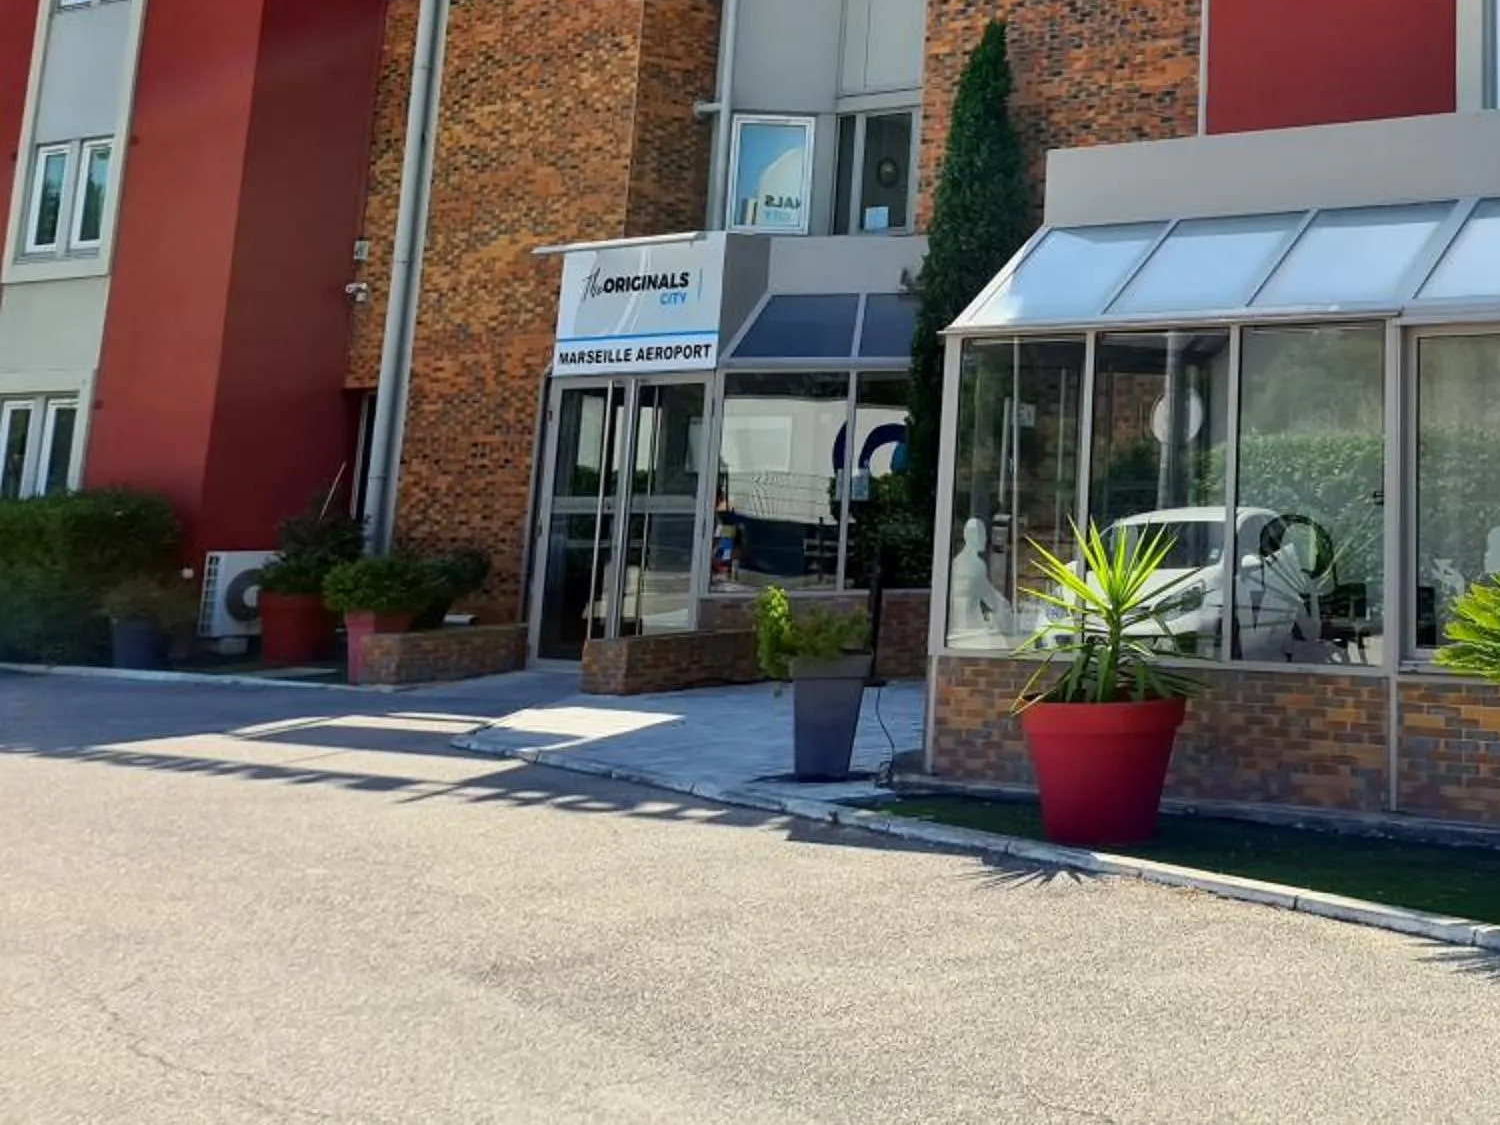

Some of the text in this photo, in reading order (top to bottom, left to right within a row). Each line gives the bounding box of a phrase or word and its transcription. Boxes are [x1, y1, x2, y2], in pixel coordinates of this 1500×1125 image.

[603, 272, 690, 293] ORIGINALS
[660, 292, 687, 305] CITY
[559, 344, 712, 364] MARSEILLE AEROPORT
